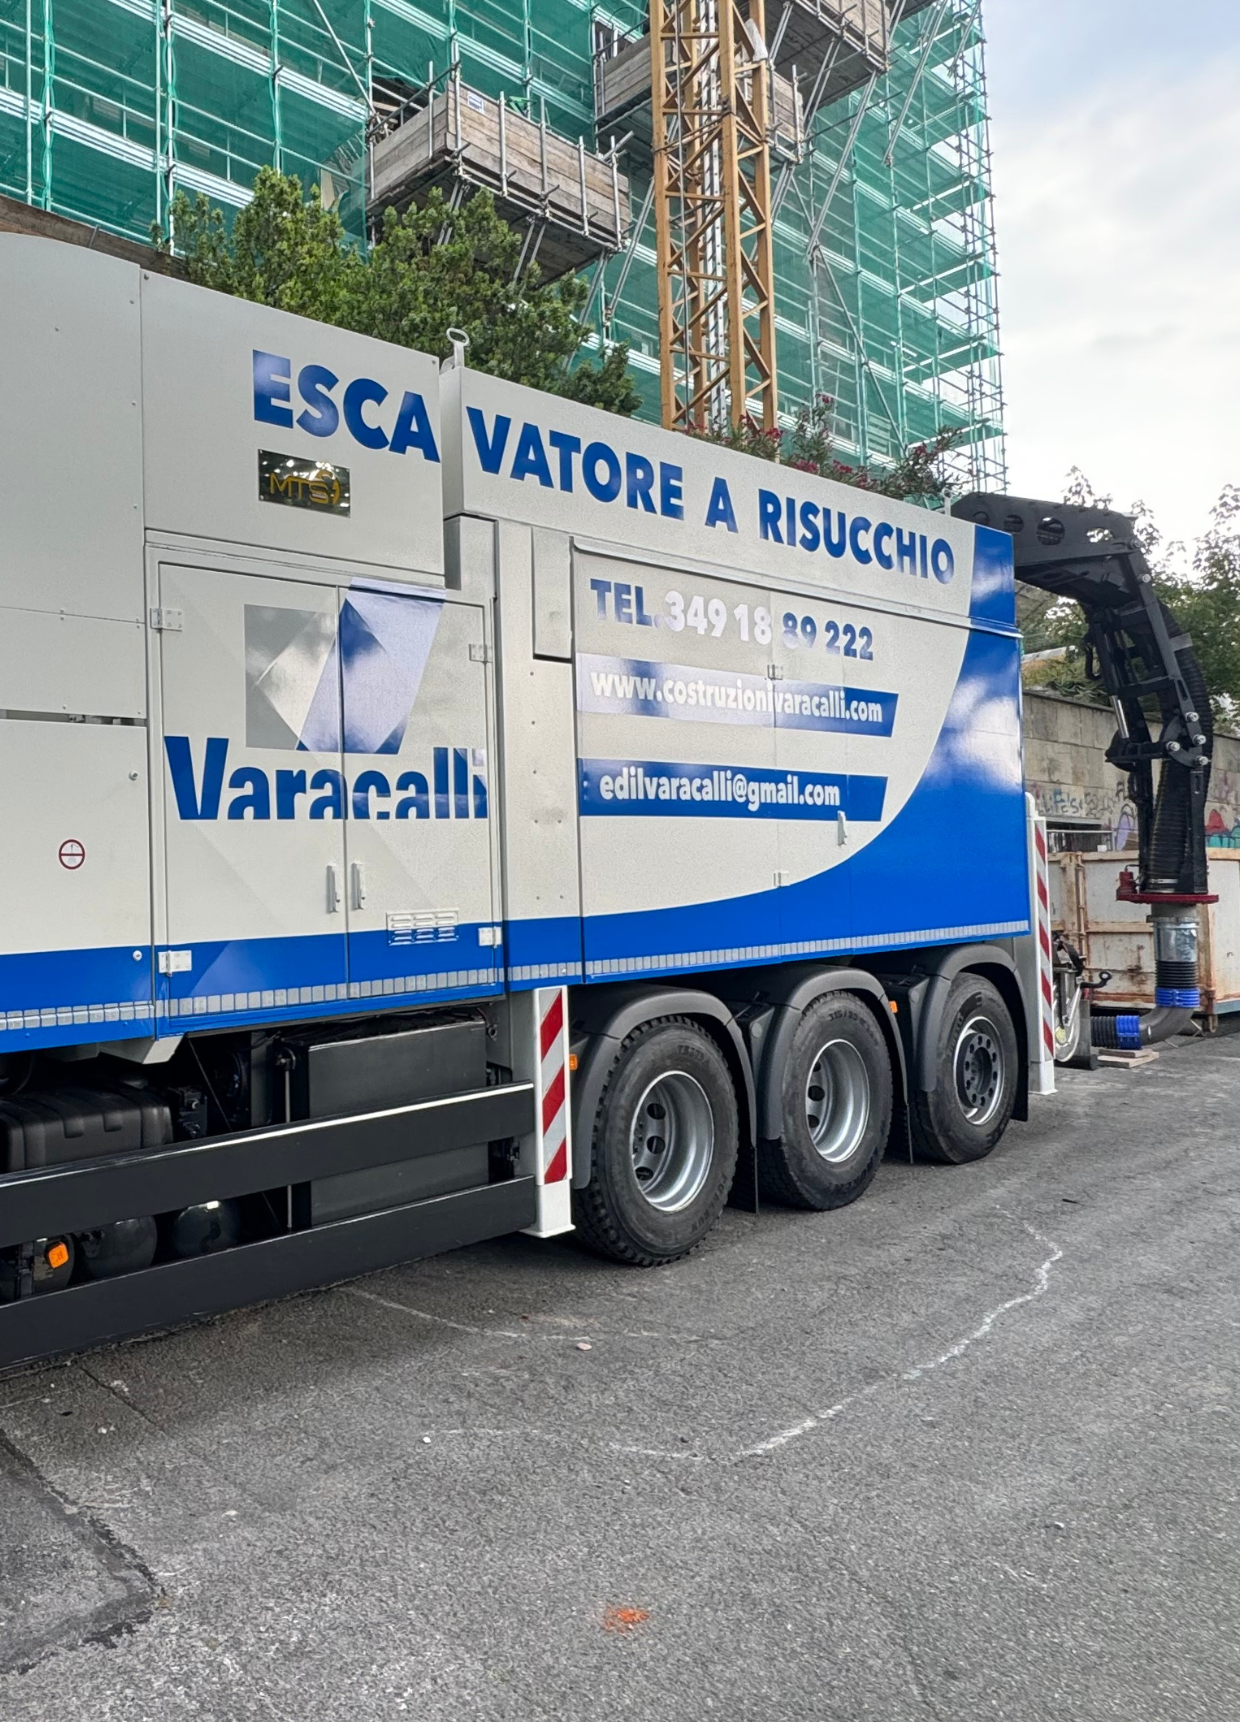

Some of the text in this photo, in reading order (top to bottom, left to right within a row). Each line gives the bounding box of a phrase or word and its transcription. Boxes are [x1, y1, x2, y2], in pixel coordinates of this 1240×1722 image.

[253, 349, 955, 584] ESCA VATORE A RISUCCHIO
[590, 578, 874, 661] TEL. 349 18 89 222
[590, 671, 882, 723] www.costruzionivaracalli.com
[163, 736, 488, 820] Varacalli
[599, 766, 840, 811] edilvaracalli@gmail.com
